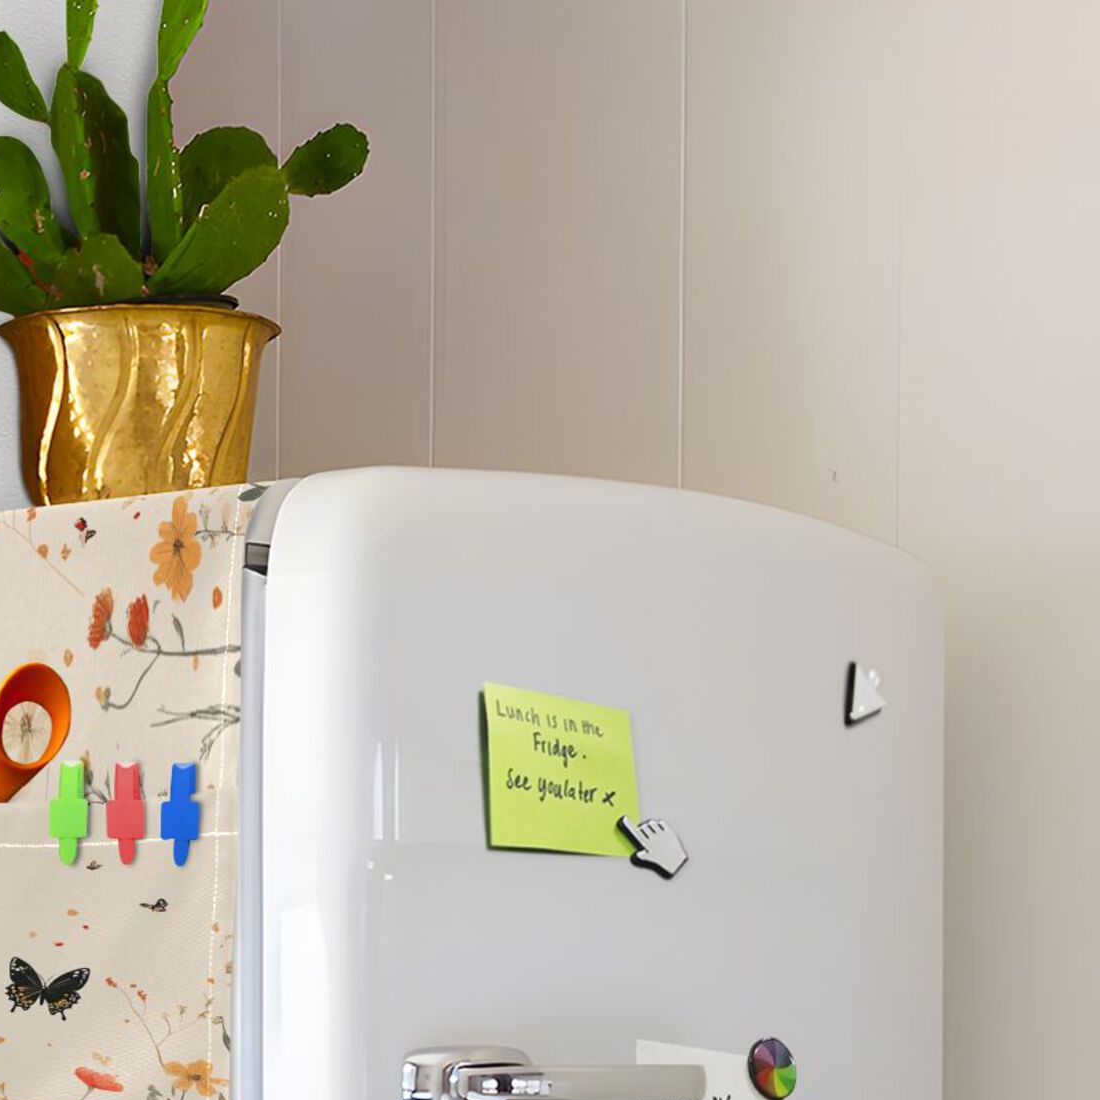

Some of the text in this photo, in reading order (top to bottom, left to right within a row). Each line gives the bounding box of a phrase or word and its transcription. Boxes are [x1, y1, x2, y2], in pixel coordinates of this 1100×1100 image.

[496, 700, 604, 738] Lunch is in the
[506, 768, 532, 790] See
